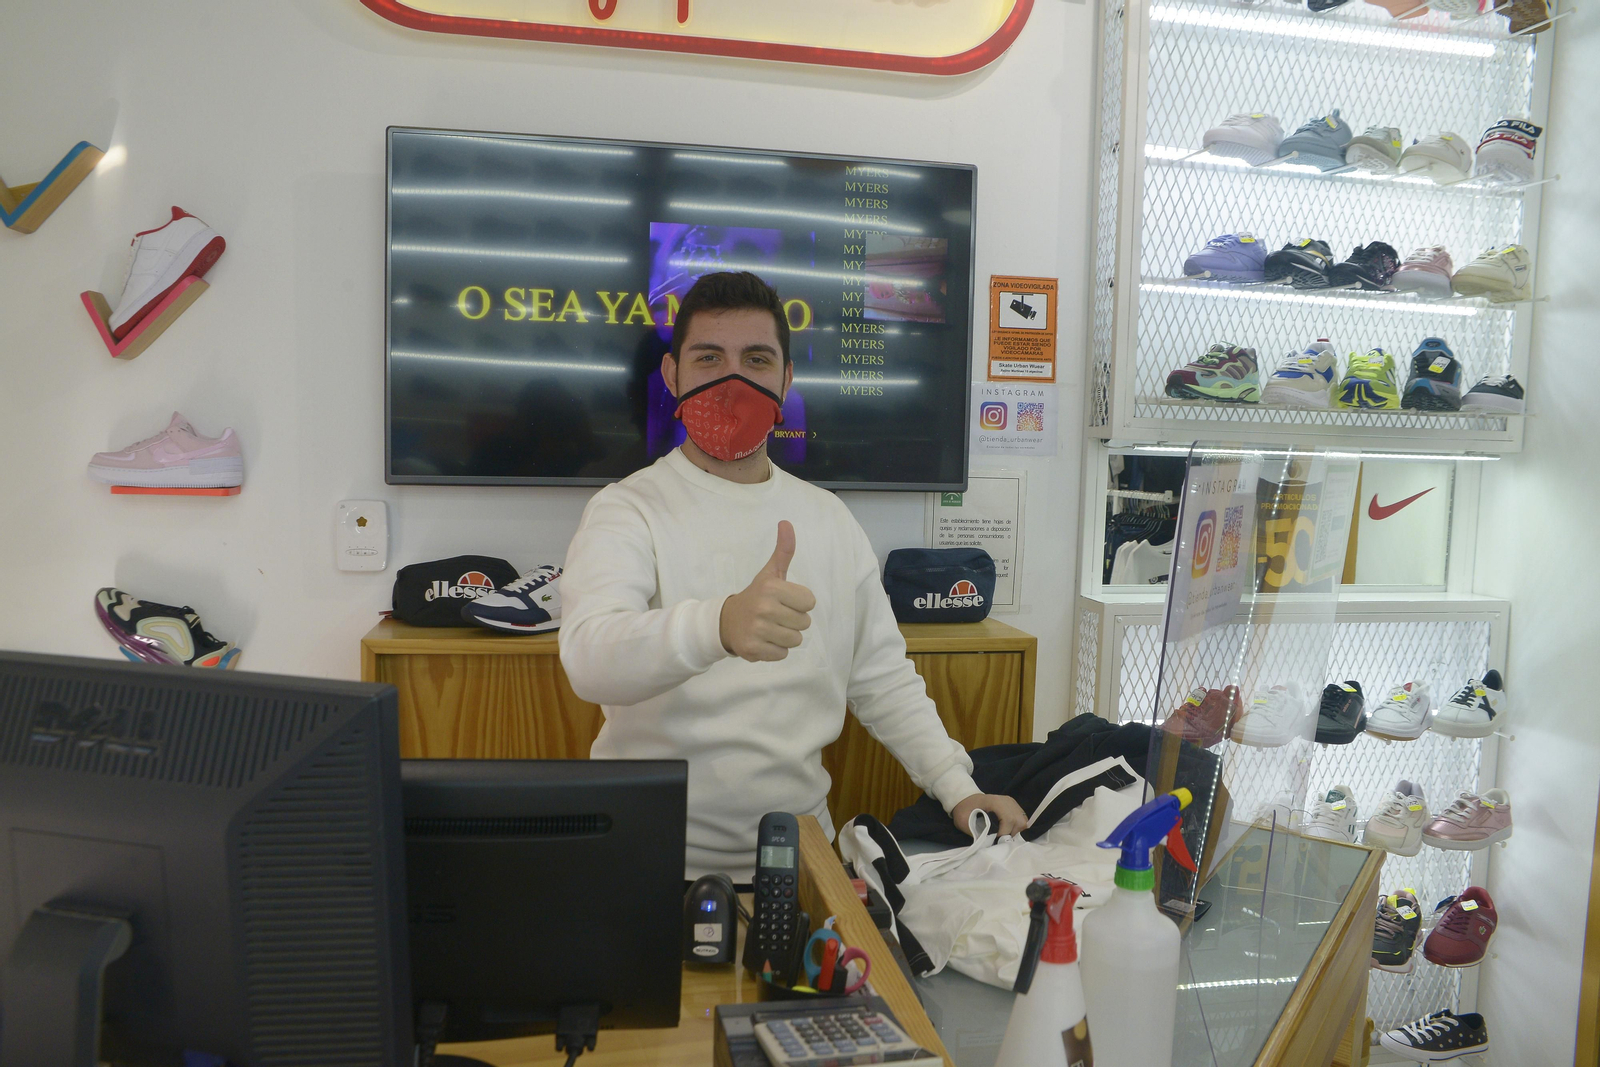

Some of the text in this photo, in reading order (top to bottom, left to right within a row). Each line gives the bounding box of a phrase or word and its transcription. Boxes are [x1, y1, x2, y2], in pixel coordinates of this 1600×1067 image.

[1511, 121, 1535, 134] FILA
[845, 166, 889, 178] MYERS
[845, 181, 889, 194] MYERS
[844, 197, 888, 210] MYERS
[844, 213, 888, 225] MYERS
[1010, 282, 1055, 290] VIDEOVIGILADA
[458, 286, 491, 320] O
[504, 287, 589, 322] SEA
[596, 291, 656, 326] YA
[841, 323, 885, 334] MYERS
[841, 338, 885, 350] MYERS
[841, 354, 884, 365] MYERS
[840, 370, 884, 380] MYERS
[840, 385, 883, 396] MYERS
[981, 388, 1045, 397] INSTAGRAM
[774, 431, 806, 439] BRYANT
[913, 592, 984, 609] ellesse
